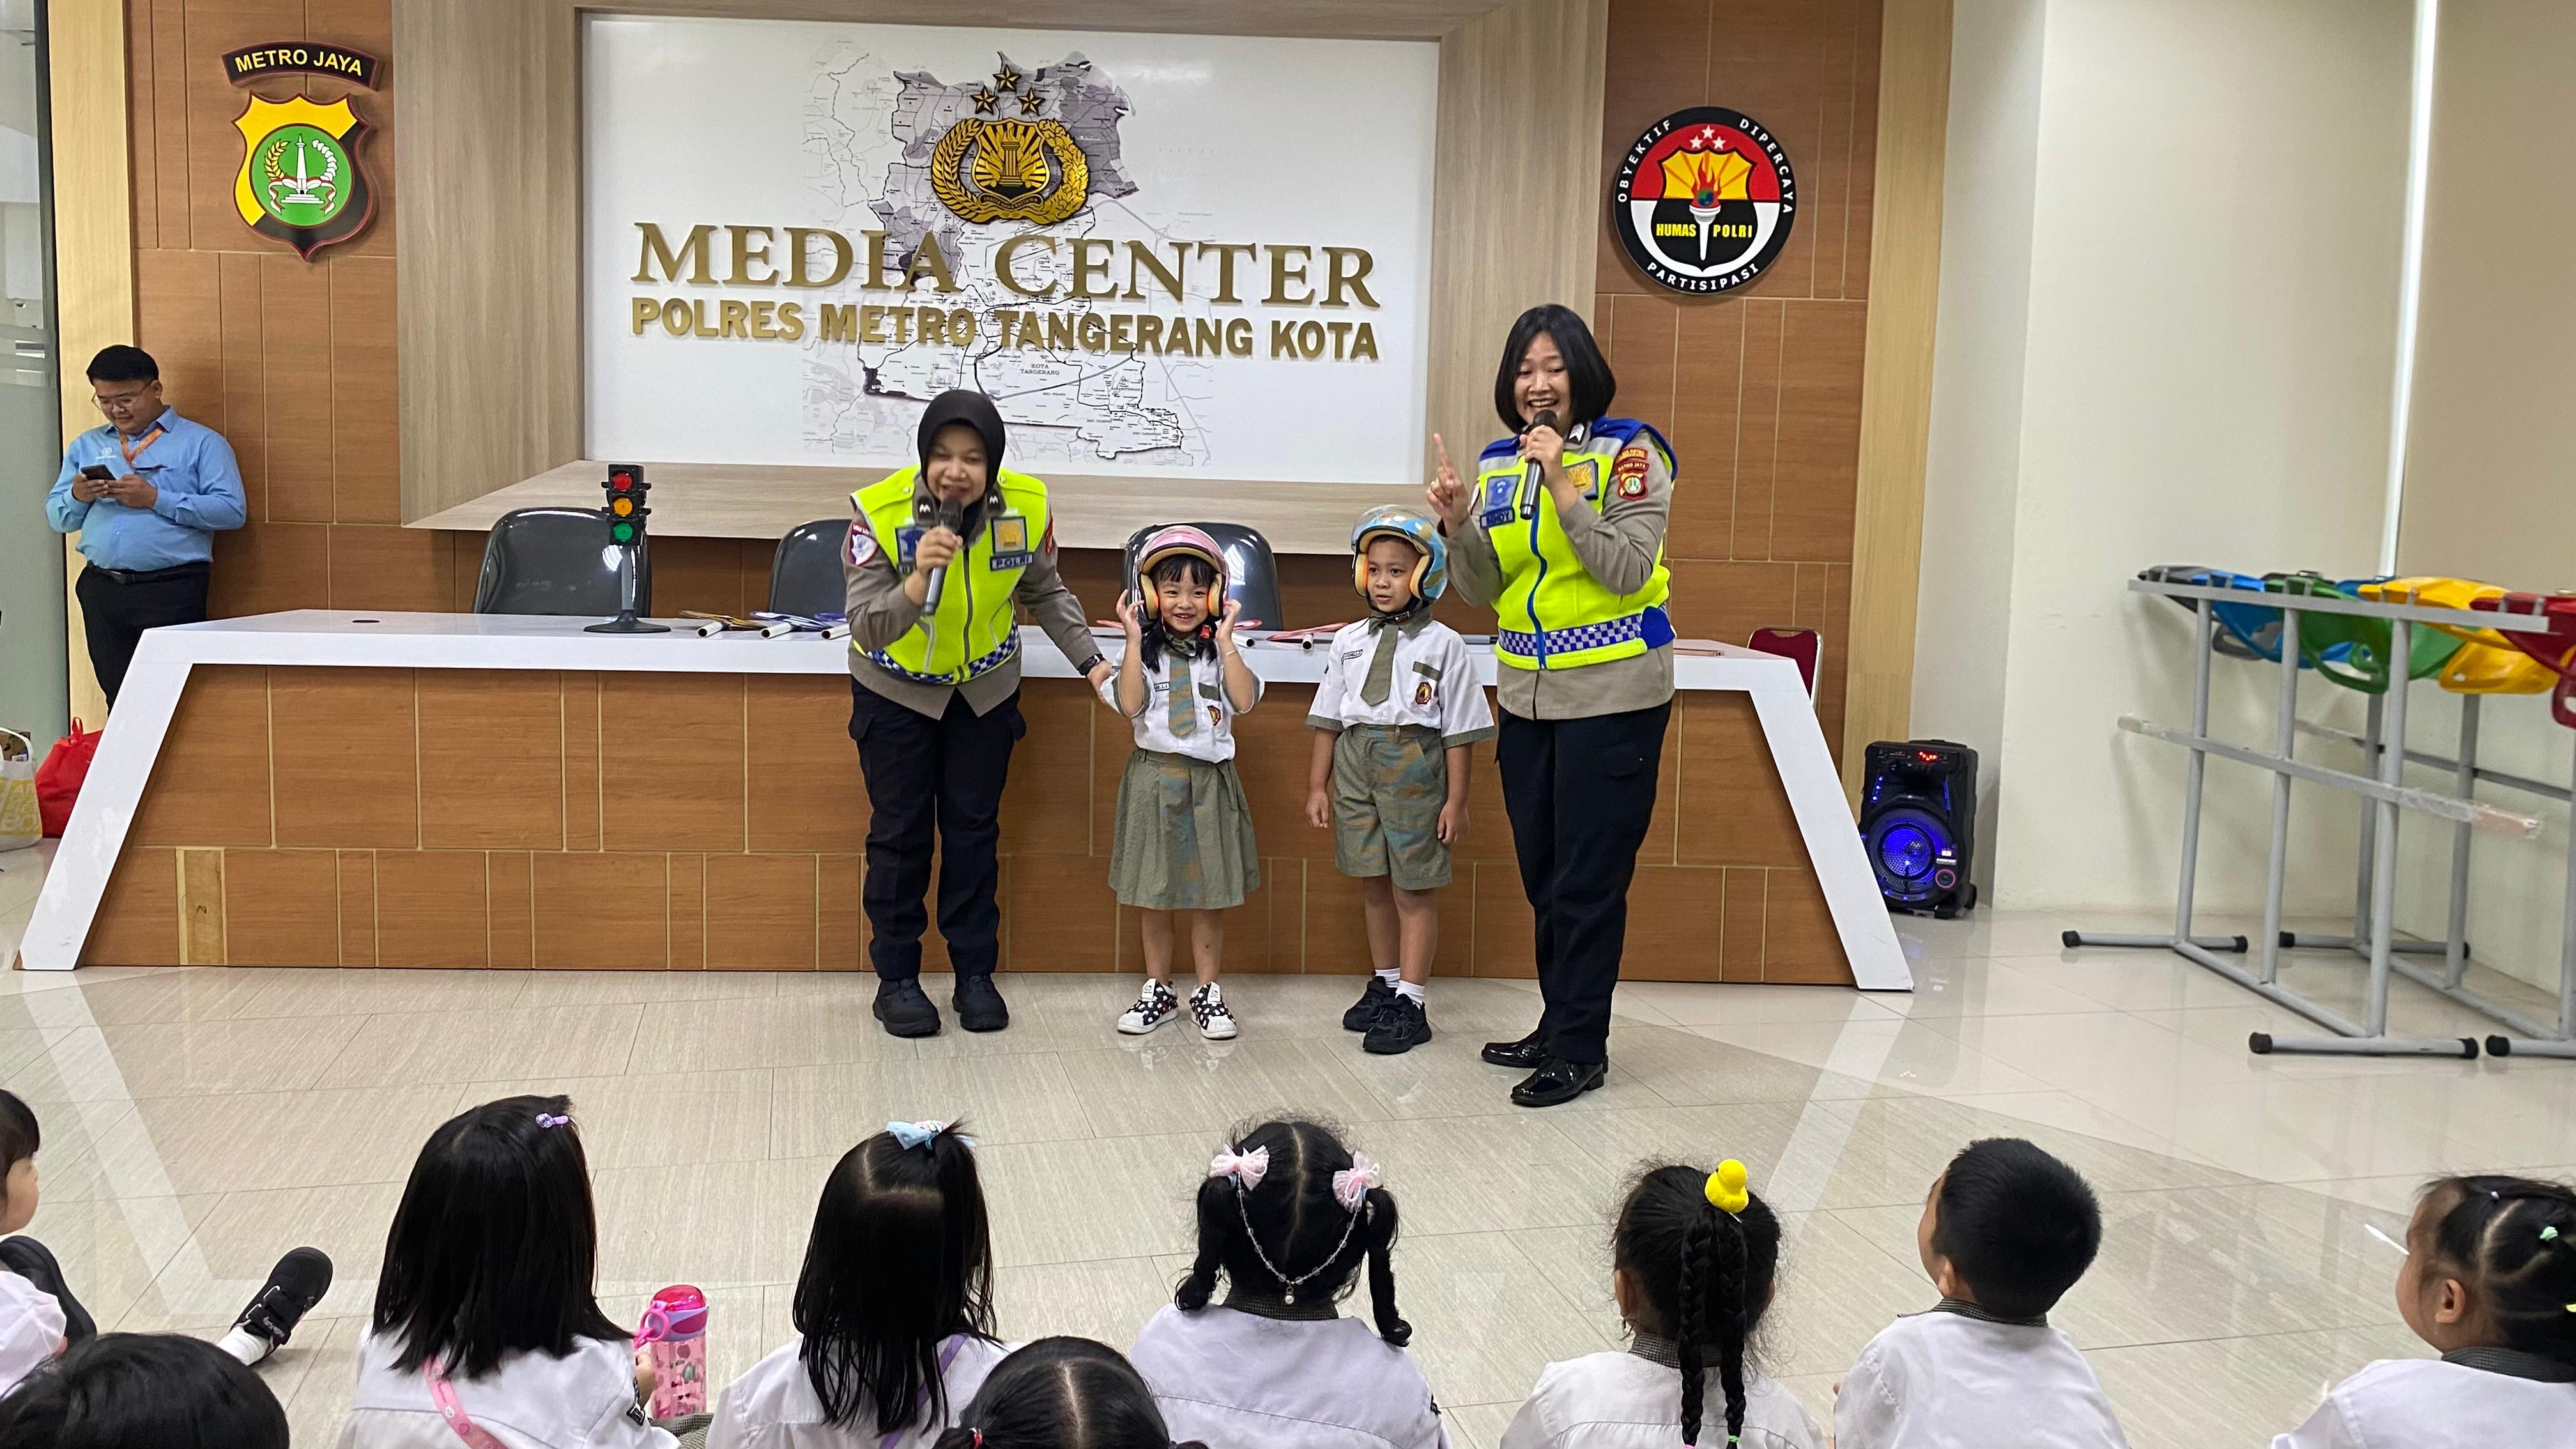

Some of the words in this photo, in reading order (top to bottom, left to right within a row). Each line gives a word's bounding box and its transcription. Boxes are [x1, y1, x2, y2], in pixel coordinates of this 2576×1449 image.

[234, 49, 308, 73] METRO
[313, 50, 362, 76] JAYA
[1618, 119, 1671, 203] OBYEKTIF
[1739, 118, 1794, 214] DIPERCAYA
[1656, 224, 1696, 237] HUMAS
[1713, 224, 1753, 238] POLRI
[630, 222, 963, 293] MEDIA
[994, 234, 1381, 309] CENTER
[1647, 262, 1759, 291] PARTISIPASI
[632, 297, 804, 341] POLRES
[820, 303, 976, 346] METRO
[993, 310, 1254, 357] TANGERANG
[1270, 320, 1379, 360] KOTA
